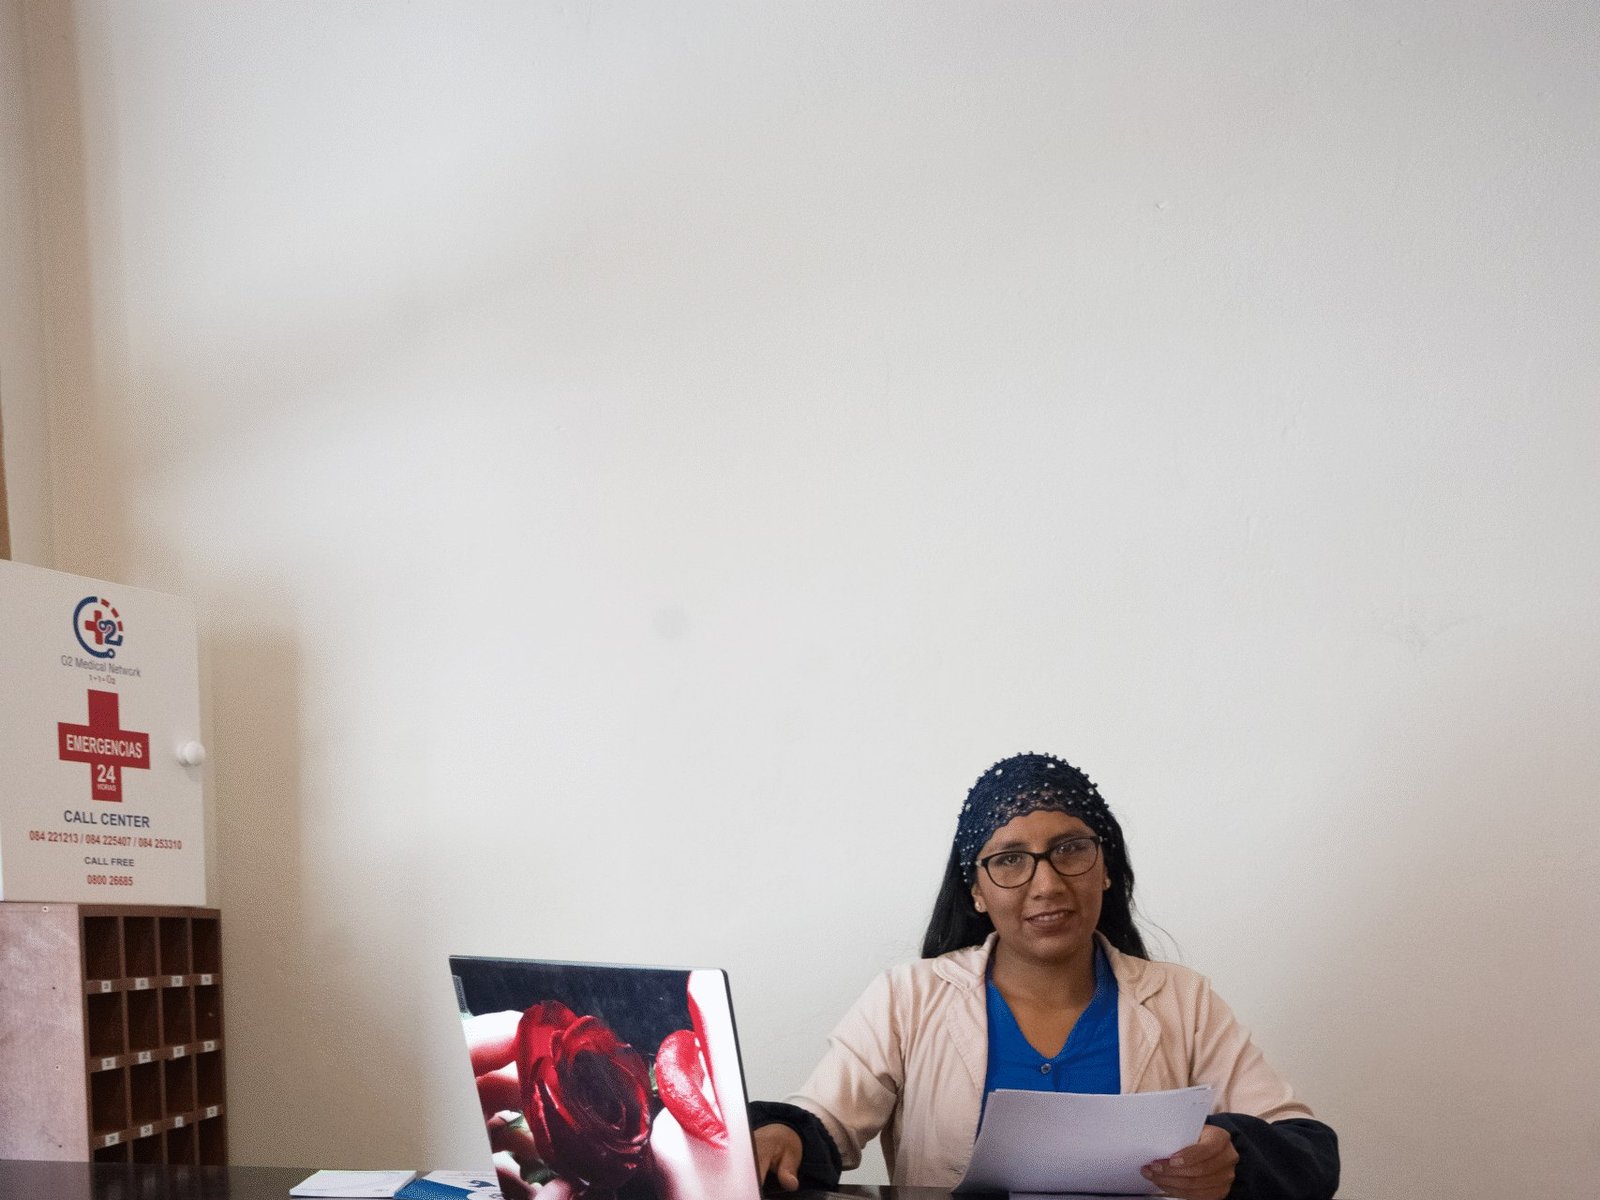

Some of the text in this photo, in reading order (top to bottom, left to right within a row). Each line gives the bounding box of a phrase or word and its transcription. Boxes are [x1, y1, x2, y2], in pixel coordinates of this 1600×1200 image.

[75, 657, 107, 672] Medical
[109, 663, 142, 678] Network
[66, 734, 143, 759] EMERGENCIAS
[97, 764, 116, 784] 24
[63, 810, 151, 828] CALL CENTER
[29, 830, 46, 842] 084
[47, 831, 79, 844] 221213
[85, 834, 101, 845] 084
[84, 856, 135, 867] CALL FREE
[87, 874, 107, 885] 0800
